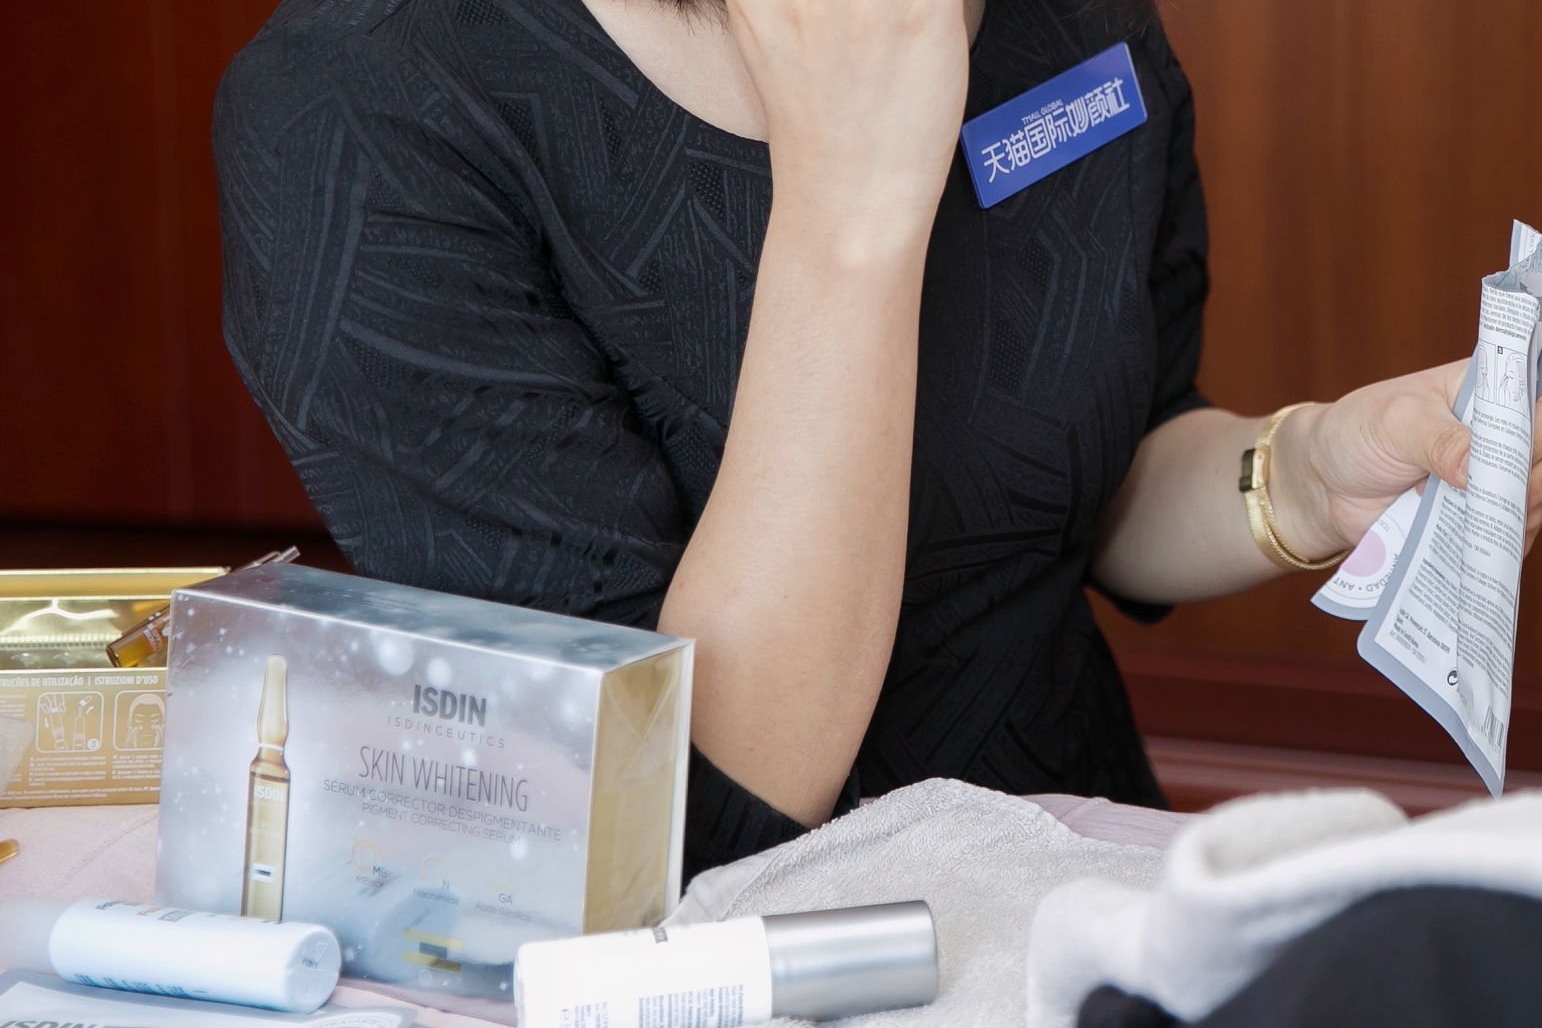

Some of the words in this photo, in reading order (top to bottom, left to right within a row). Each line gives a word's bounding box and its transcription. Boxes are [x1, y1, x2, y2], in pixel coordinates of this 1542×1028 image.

[1021, 109, 1041, 126] TMALL
[1040, 99, 1064, 115] GLOBAL
[981, 77, 1130, 183] 天猫国际妙颜社
[31, 677, 40, 687] DE
[42, 675, 84, 687] UTILIZAÇÃO
[95, 676, 134, 686] ISTRUZIONI
[412, 684, 487, 728] ISDIN
[387, 715, 505, 749] ISDINCEUTICS
[253, 784, 284, 803] ISDIN
[358, 745, 405, 786] SKIN
[412, 757, 528, 812] WHITENING
[323, 779, 366, 799] SÉRUM
[368, 789, 445, 816] CORRECTOR
[448, 805, 561, 841] DESPIGMENTANTE
[362, 802, 409, 822] PIGMENT
[410, 813, 481, 838] CORRECTING
[483, 828, 521, 846] SERUM
[372, 865, 388, 878] MB
[498, 893, 513, 905] GA
